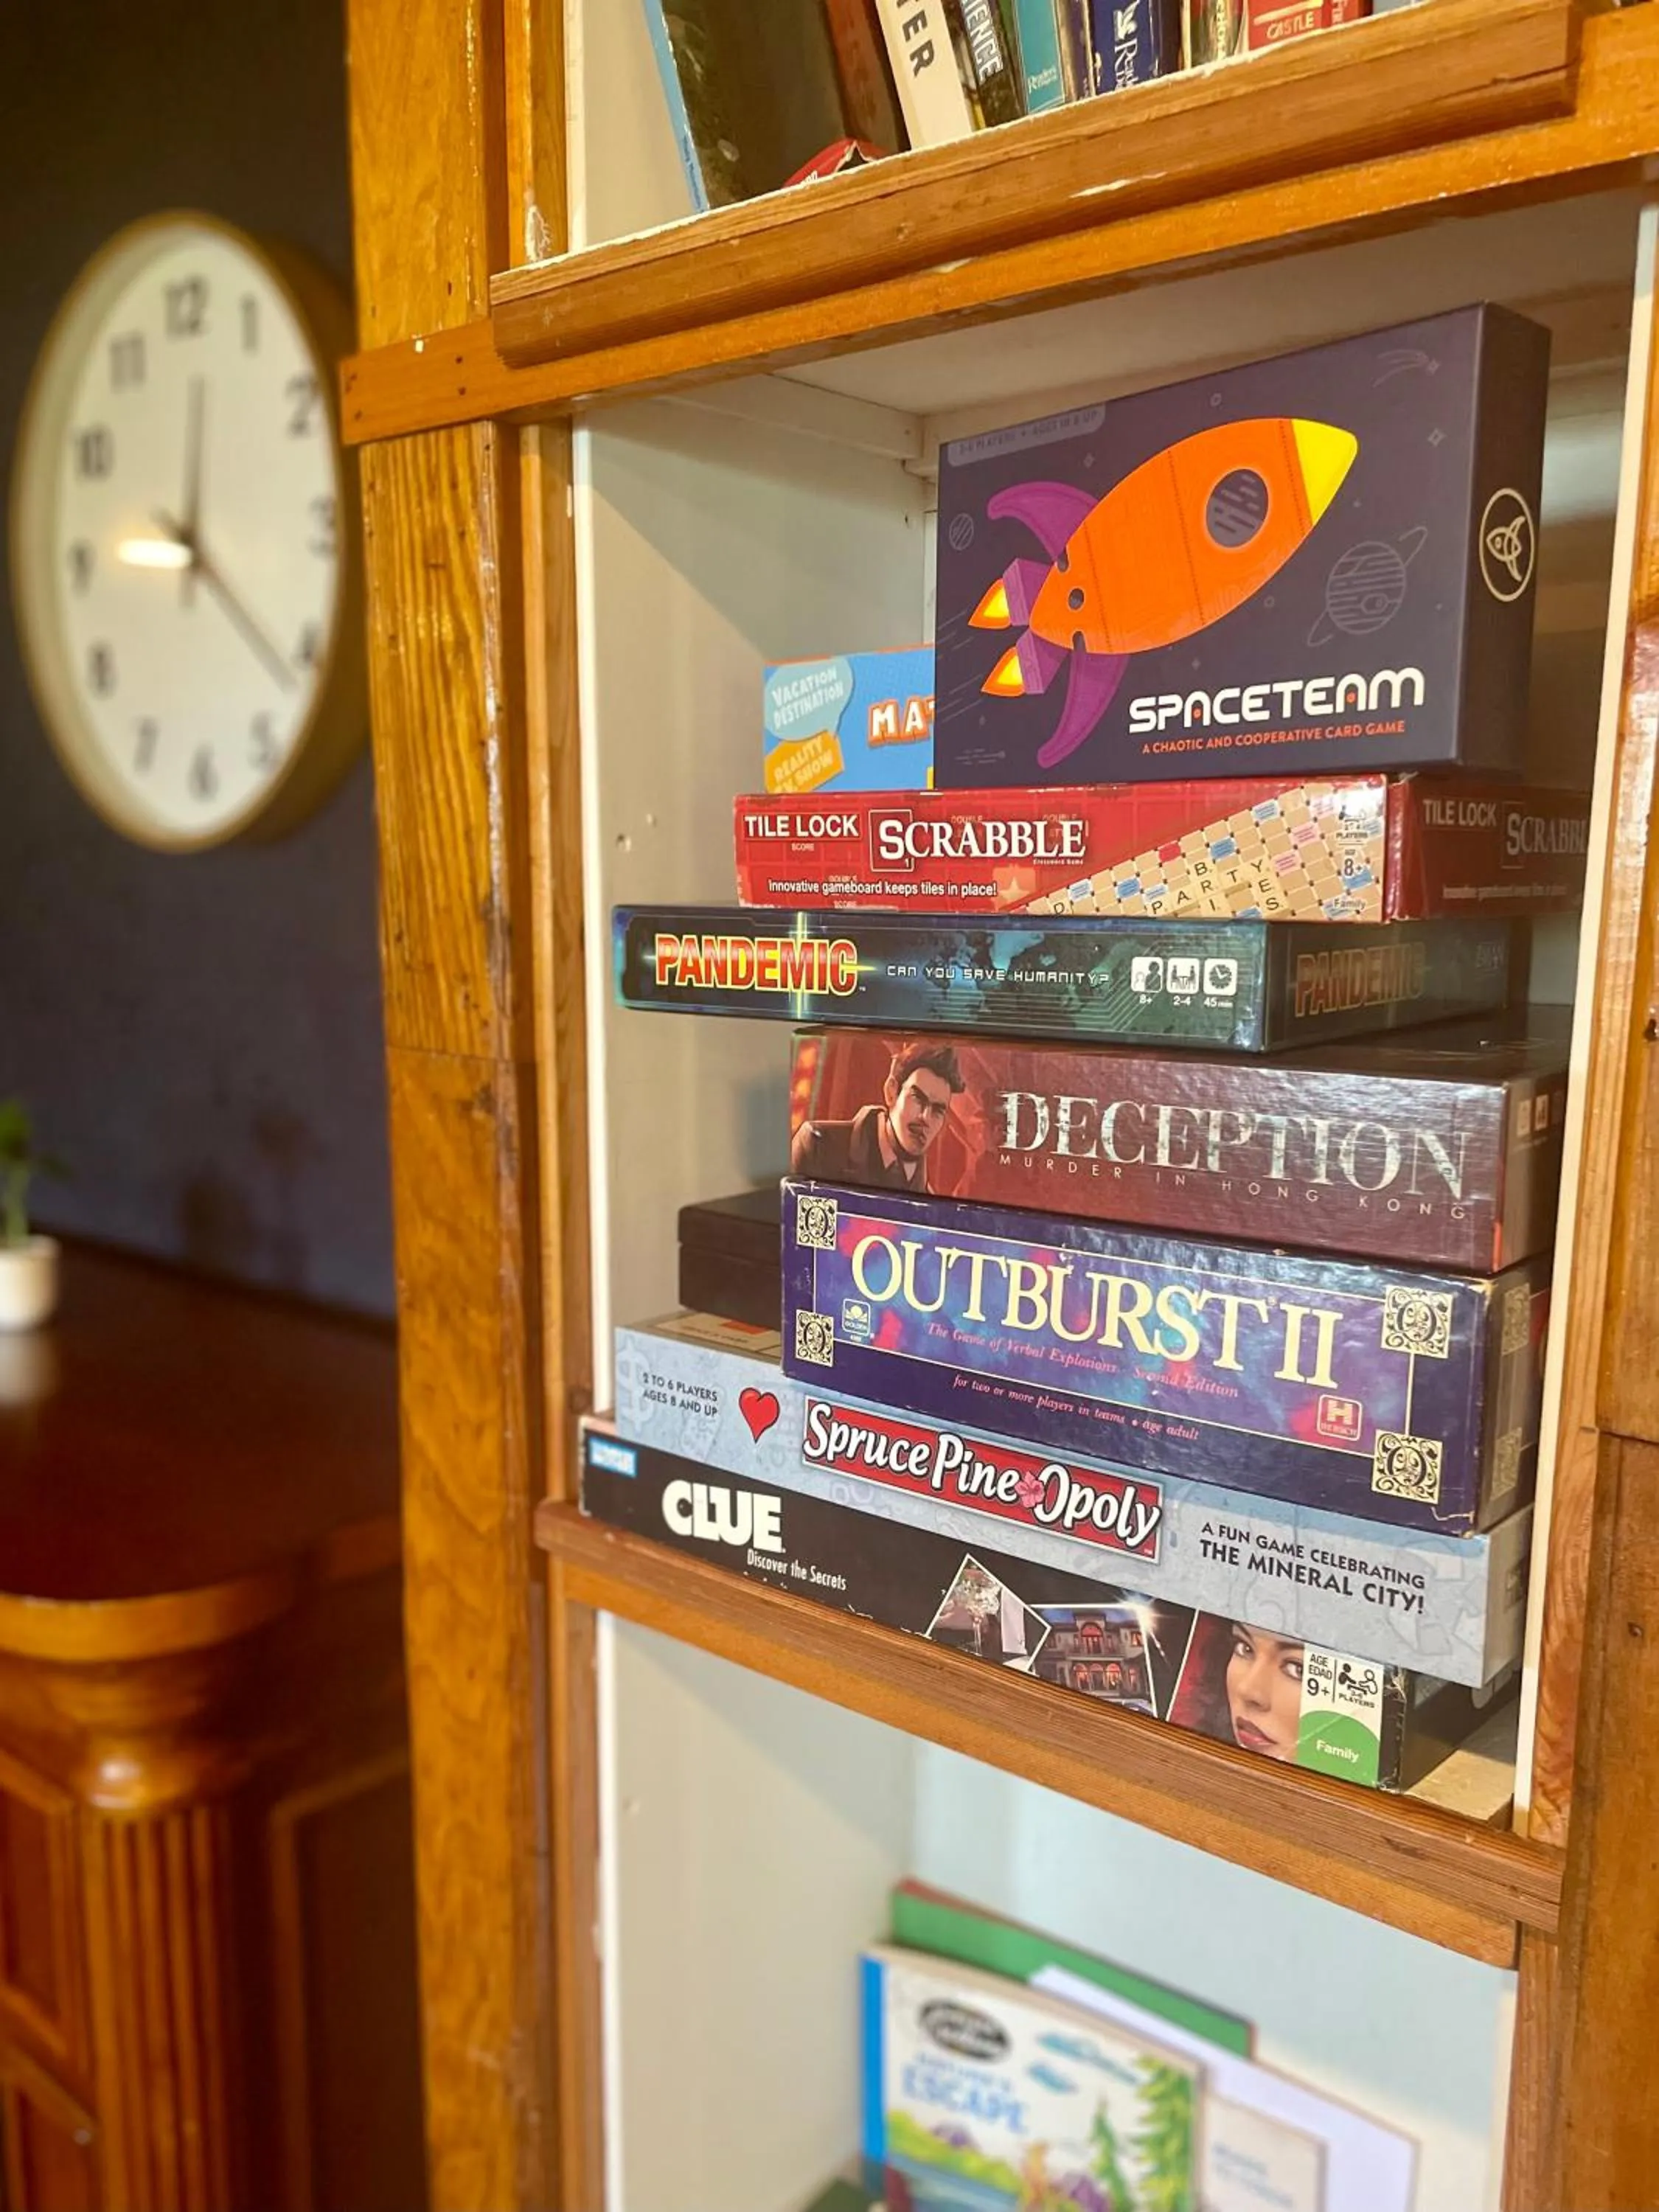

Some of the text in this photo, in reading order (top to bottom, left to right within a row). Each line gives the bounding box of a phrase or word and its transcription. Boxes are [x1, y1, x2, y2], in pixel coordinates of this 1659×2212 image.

[897, 0, 935, 77] ER
[961, 0, 1004, 85] IENCE
[1266, 12, 1315, 40] CASTLE
[163, 276, 208, 336] 12
[242, 293, 258, 352] 1
[110, 331, 145, 393] 11
[285, 372, 319, 437] 2
[77, 428, 112, 481] 10
[70, 539, 92, 591] 9
[89, 641, 112, 699] 8
[772, 666, 838, 706] VACATION
[773, 683, 844, 731] DESTINATION
[871, 699, 935, 739] MA
[1129, 667, 1425, 734] SPACETEAM
[135, 717, 157, 772] 7
[248, 713, 278, 771] 5
[774, 739, 824, 782] REALITY
[1142, 720, 1405, 754] A CHAOTIC AND COOPERATIVE CARD GAME
[189, 744, 217, 802] 6
[796, 750, 834, 785] SHOW
[744, 815, 859, 838] TILE LOCK
[878, 818, 1087, 860] SCRABBLE
[1423, 799, 1497, 827] TILE LOCK
[768, 879, 997, 899] Innovative gameboard keeps tiles in place!
[1334, 899, 1366, 911] Family
[654, 933, 858, 996] PANDEMIC
[887, 965, 1109, 985] CAN YOU SAVE HUMANITY?
[1294, 941, 1427, 1018] PANDEMIC
[1173, 996, 1192, 1006] 2-4
[997, 1090, 1472, 1201] DECEPTION
[998, 1152, 1466, 1221] MURDER IN HONG KONG
[851, 1234, 1344, 1390] OUTBURST II
[642, 1371, 718, 1402] 2 TO 6 PLAYERS
[928, 1322, 1239, 1399] The Game of Verbal Explosions Second Edition
[642, 1389, 667, 1404] AGES
[679, 1399, 702, 1413] AND
[704, 1405, 718, 1417] UP
[953, 1374, 1200, 1441] for two or more players in teams age adult
[803, 1402, 1162, 1548] Spruce Pine Opoly
[661, 1478, 784, 1554] CLUE
[747, 1548, 848, 1593] Discover the Secrets
[1200, 1538, 1425, 1615] THE MINERAL CITY!
[1201, 1521, 1426, 1590] A FUN GAME CELEBRATING
[1308, 1664, 1333, 1680] EDAD
[1310, 1653, 1329, 1668] AGE
[1307, 1677, 1330, 1697] 9+
[1338, 1692, 1376, 1709] PLAYERS
[1315, 1739, 1360, 1763] Family
